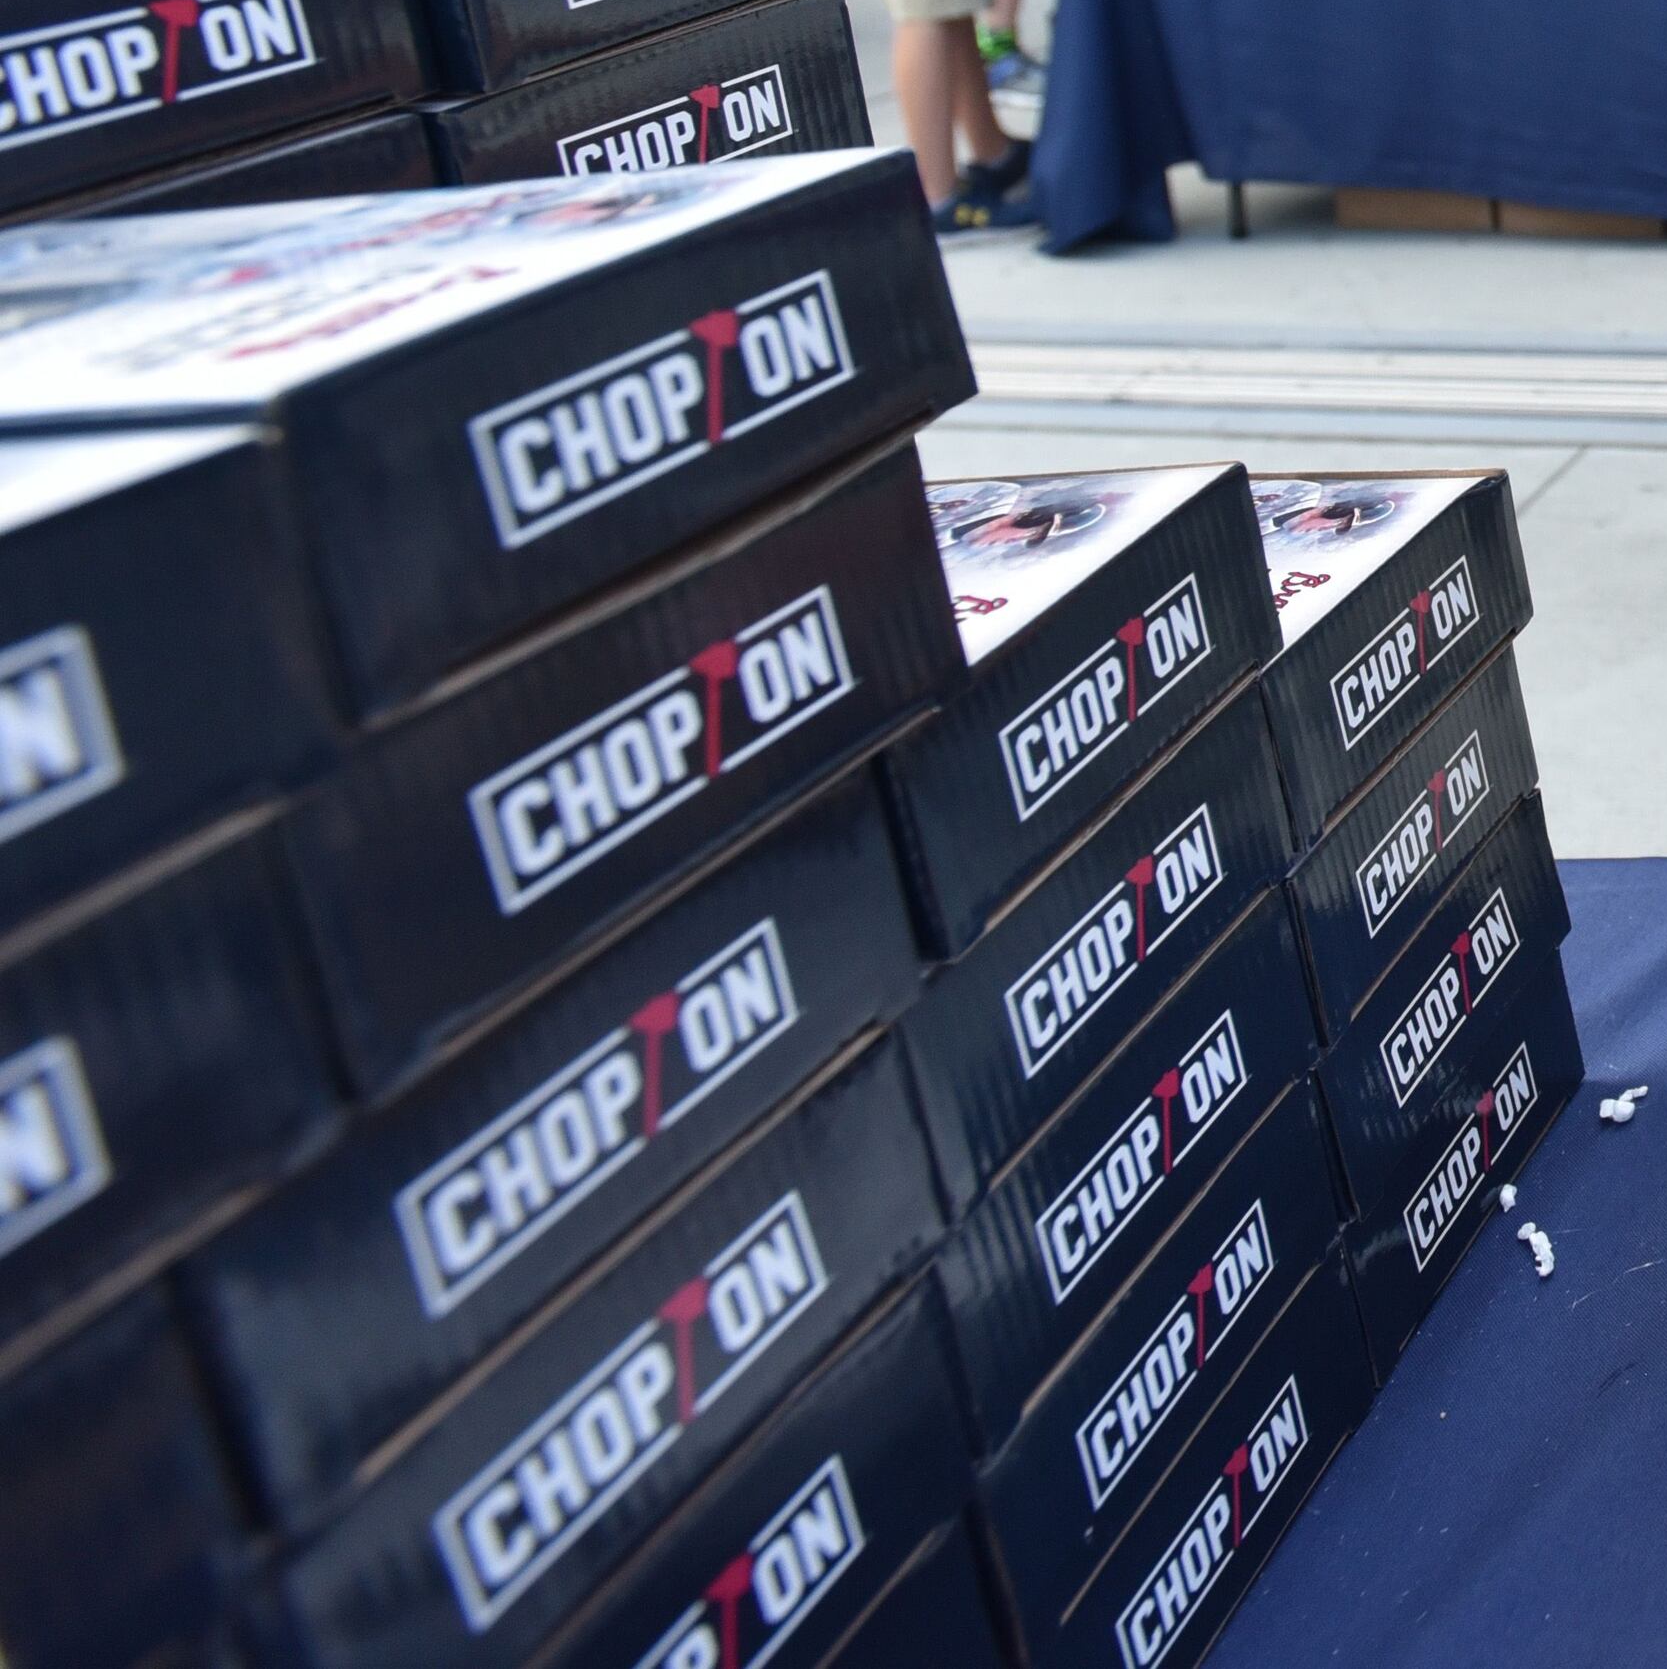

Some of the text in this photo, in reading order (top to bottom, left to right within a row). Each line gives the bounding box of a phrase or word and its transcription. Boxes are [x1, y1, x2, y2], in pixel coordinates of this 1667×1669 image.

[573, 80, 781, 175] CHOP ON
[498, 295, 837, 514] CHOP ON
[496, 611, 832, 878] CHOP ON
[1015, 595, 1199, 794] CHOP ON
[1341, 572, 1469, 733] CHOP ON
[1019, 826, 1212, 1050] CHOP ON
[1365, 746, 1483, 917] CHOP ON
[1390, 904, 1513, 1087] CHOP ON
[424, 945, 778, 1276] CHOP ON
[1050, 1031, 1236, 1276] CHOP ON
[1410, 1058, 1531, 1250] CHOP ON
[461, 1220, 807, 1589] CHOP ON
[1088, 1217, 1265, 1482] CHOP ON
[752, 1485, 846, 1628] ON
[1127, 1394, 1300, 1667] CHOP ON
